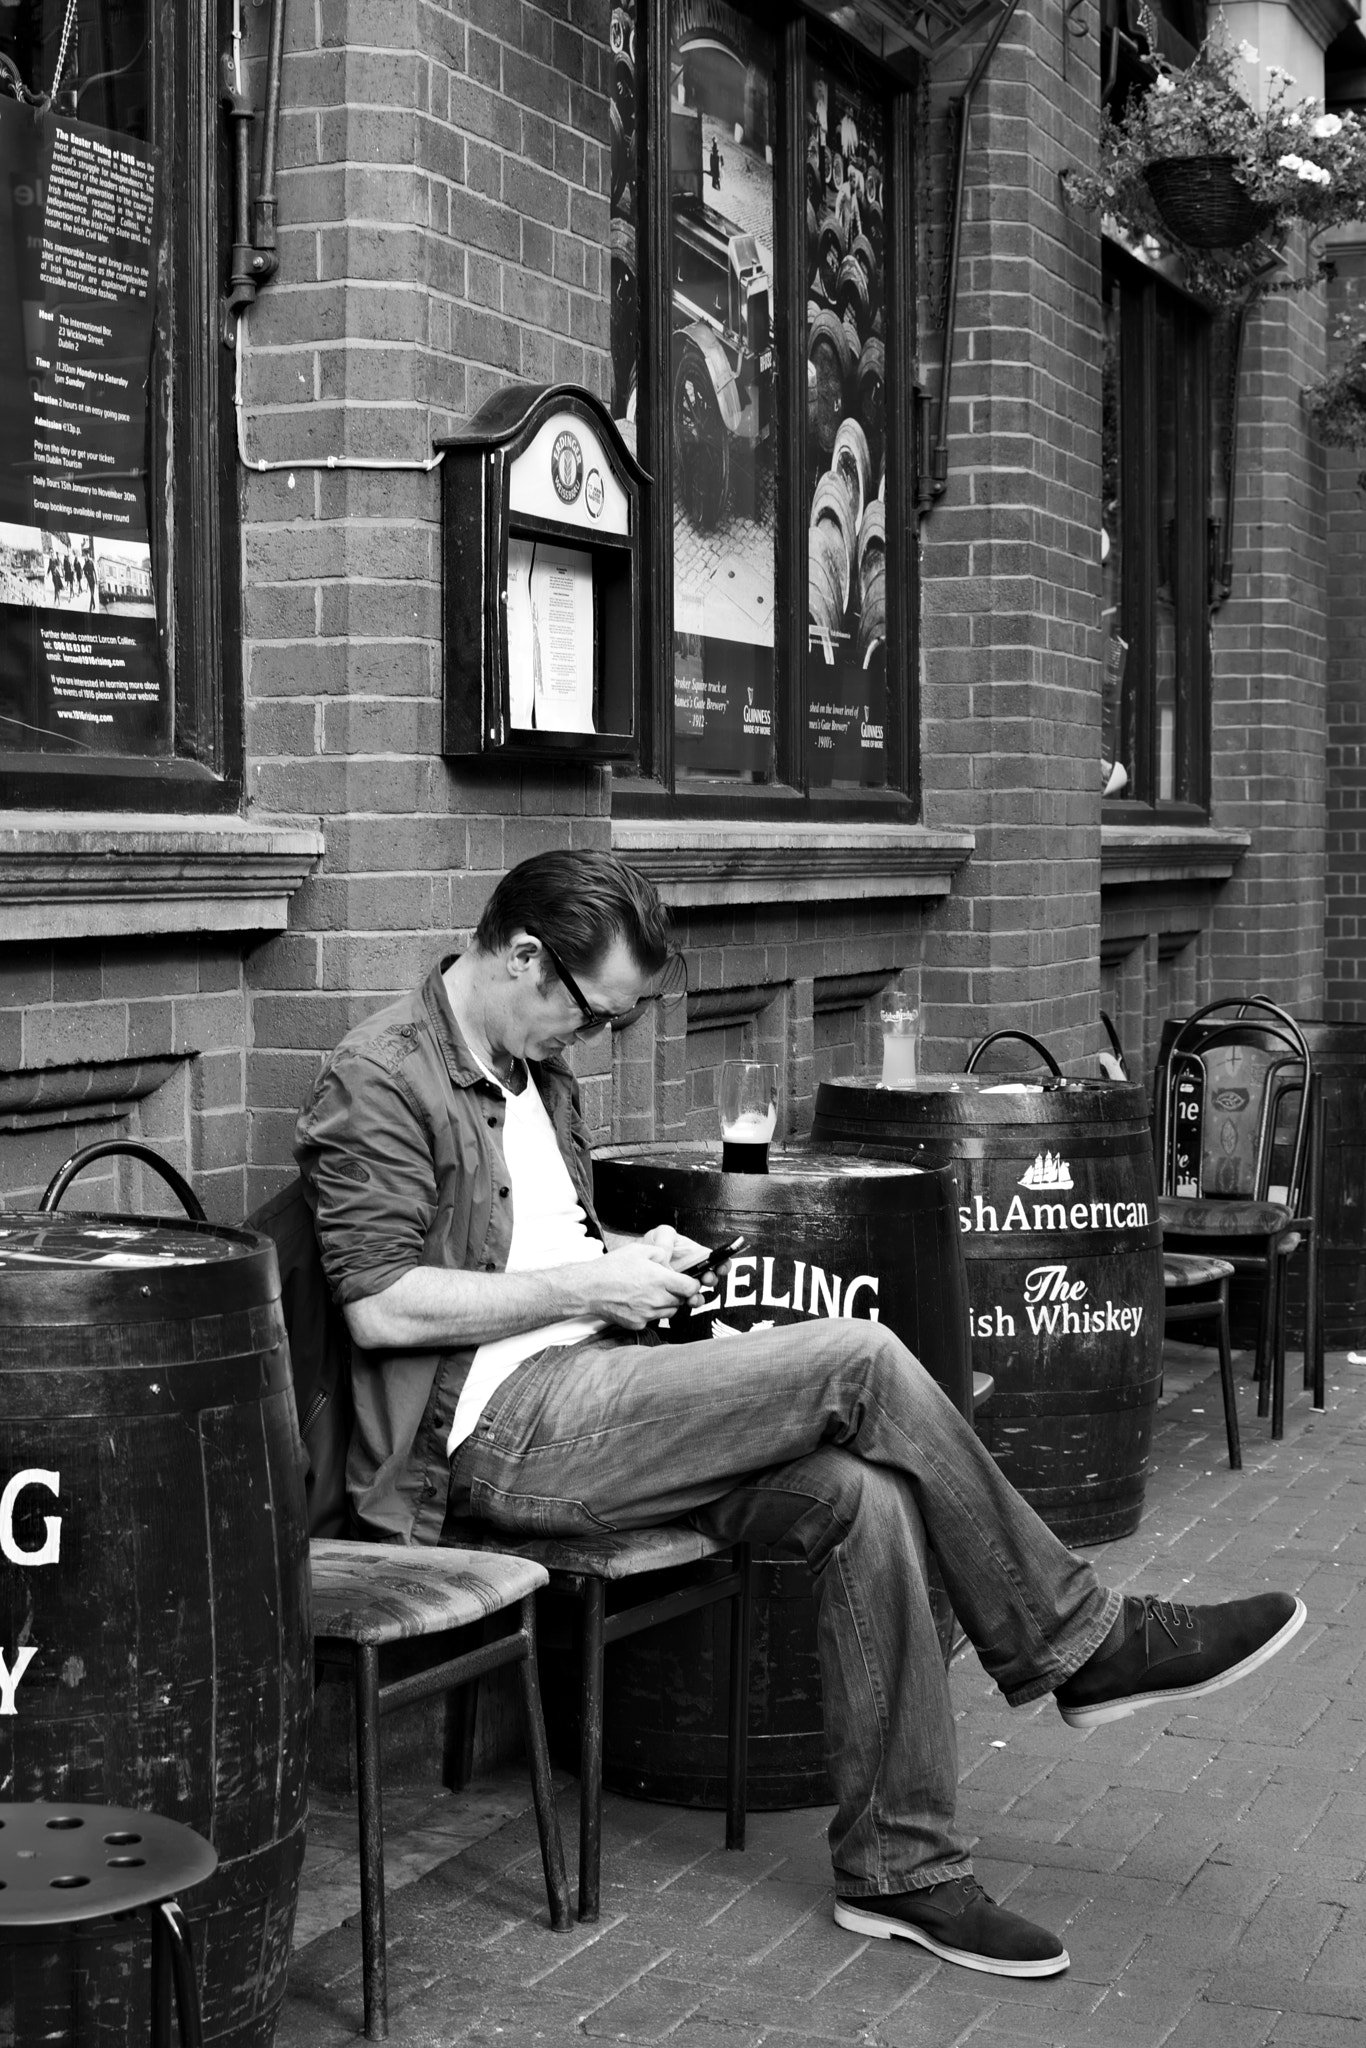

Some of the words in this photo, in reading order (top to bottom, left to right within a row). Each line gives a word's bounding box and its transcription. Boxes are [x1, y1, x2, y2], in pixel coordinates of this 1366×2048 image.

[56, 128, 69, 141] The
[71, 133, 91, 149] Easter
[93, 141, 111, 159] Rising
[113, 150, 119, 160] of
[121, 152, 135, 166] 1916
[53, 151, 76, 166] Ireland's
[78, 160, 100, 174] struggle
[54, 141, 69, 152] most
[71, 146, 95, 161] dramatic
[97, 156, 111, 167] event
[113, 161, 118, 170] in
[120, 163, 128, 174] the
[130, 167, 147, 182] history
[51, 163, 81, 179] executions
[82, 173, 88, 181] of
[89, 174, 98, 185] the
[99, 178, 117, 191] leaders
[48, 183, 61, 196] Irish
[91, 199, 115, 214] resulting
[50, 175, 78, 189] awakened
[86, 186, 114, 200] generation
[123, 197, 132, 207] the
[133, 201, 147, 212] cause
[46, 205, 73, 221] formation
[81, 217, 90, 227] the
[91, 219, 102, 230] Irish
[103, 223, 115, 234] Free
[116, 227, 130, 239] State
[63, 223, 72, 233] the
[73, 225, 84, 236] Irish
[85, 229, 96, 240] Civil
[41, 250, 54, 261] sites
[55, 254, 61, 263] of
[63, 256, 77, 268] these
[78, 261, 96, 273] battles
[98, 267, 105, 275] as
[106, 269, 115, 278] the
[116, 272, 148, 287] complexities
[43, 238, 53, 250] This
[54, 244, 85, 259] memorable
[86, 252, 97, 261] tour
[98, 256, 107, 265] will
[108, 257, 122, 271] bring
[123, 263, 132, 272] you
[134, 265, 139, 274] to
[141, 267, 149, 277] the
[40, 273, 66, 287] accessible
[67, 281, 77, 290] and
[78, 284, 97, 295] concise
[41, 261, 47, 270] of
[50, 263, 62, 274] Irish
[66, 268, 85, 282] history
[88, 275, 97, 284] are
[101, 279, 127, 293] explained
[130, 286, 135, 295] in
[39, 309, 54, 321] Meet
[60, 315, 69, 326] The
[70, 317, 102, 334] International
[58, 326, 65, 336] 23
[66, 328, 87, 341] Wicklow
[58, 338, 74, 350] Dublin
[75, 342, 79, 351] 2
[36, 356, 50, 369] Time
[55, 373, 64, 384] 1pm
[65, 376, 85, 390] Sunday
[76, 366, 97, 381] Monday
[98, 372, 104, 381] to
[105, 373, 128, 388] Saturday
[34, 392, 58, 406] Duration
[59, 398, 62, 407] 2
[63, 400, 77, 410] hours
[84, 405, 91, 413] an
[92, 407, 103, 417] easy
[104, 409, 117, 421] going
[118, 412, 130, 422] pace
[34, 416, 62, 431] Admission
[34, 439, 43, 451] Pay
[51, 444, 59, 454] the
[60, 445, 70, 457] day
[77, 450, 86, 459] get
[87, 452, 98, 461] your
[99, 453, 115, 464] tickets
[34, 451, 45, 462] from
[46, 454, 62, 465] Dublin
[62, 457, 82, 469] Tourism
[553, 435, 581, 466] ERDINGER
[33, 475, 45, 487] Daily
[46, 478, 60, 488] Tours
[61, 481, 71, 490] 15th
[72, 483, 91, 496] January
[92, 487, 97, 495] to
[98, 487, 123, 500] November
[124, 492, 136, 502] 30th
[34, 499, 49, 511] Group
[50, 502, 72, 515] bookings
[73, 506, 95, 518] available
[102, 512, 113, 521] year
[113, 514, 129, 523] round
[40, 629, 60, 639] Further
[60, 631, 77, 641] details
[78, 634, 98, 643] contact
[98, 635, 117, 644] Lorcan
[53, 686, 62, 695] the
[63, 688, 78, 697] events
[78, 689, 83, 697] of
[83, 690, 94, 699] 1916
[95, 690, 114, 701] please
[114, 691, 126, 700] visit
[127, 692, 136, 700] our
[56, 676, 65, 685] you
[74, 677, 98, 688] interested
[99, 679, 105, 688] in
[105, 679, 128, 691] learning
[129, 682, 143, 690] more
[144, 681, 160, 690] about
[708, 681, 720, 693] truck
[57, 710, 114, 724] www.1916rising.com
[744, 705, 770, 725] GUINNESS
[820, 705, 825, 713] on
[833, 704, 844, 715] lower
[844, 705, 854, 716] level
[744, 725, 754, 734] MADE
[755, 725, 760, 734] OF
[760, 726, 771, 735] MORE
[861, 721, 883, 739] GUINNESS
[861, 740, 870, 748] MADE
[870, 740, 875, 748] OF
[875, 740, 883, 749] MORE
[658, 1254, 879, 1328] ELING
[1023, 1265, 1089, 1303] The
[1025, 1300, 1143, 1337] Whiskey
